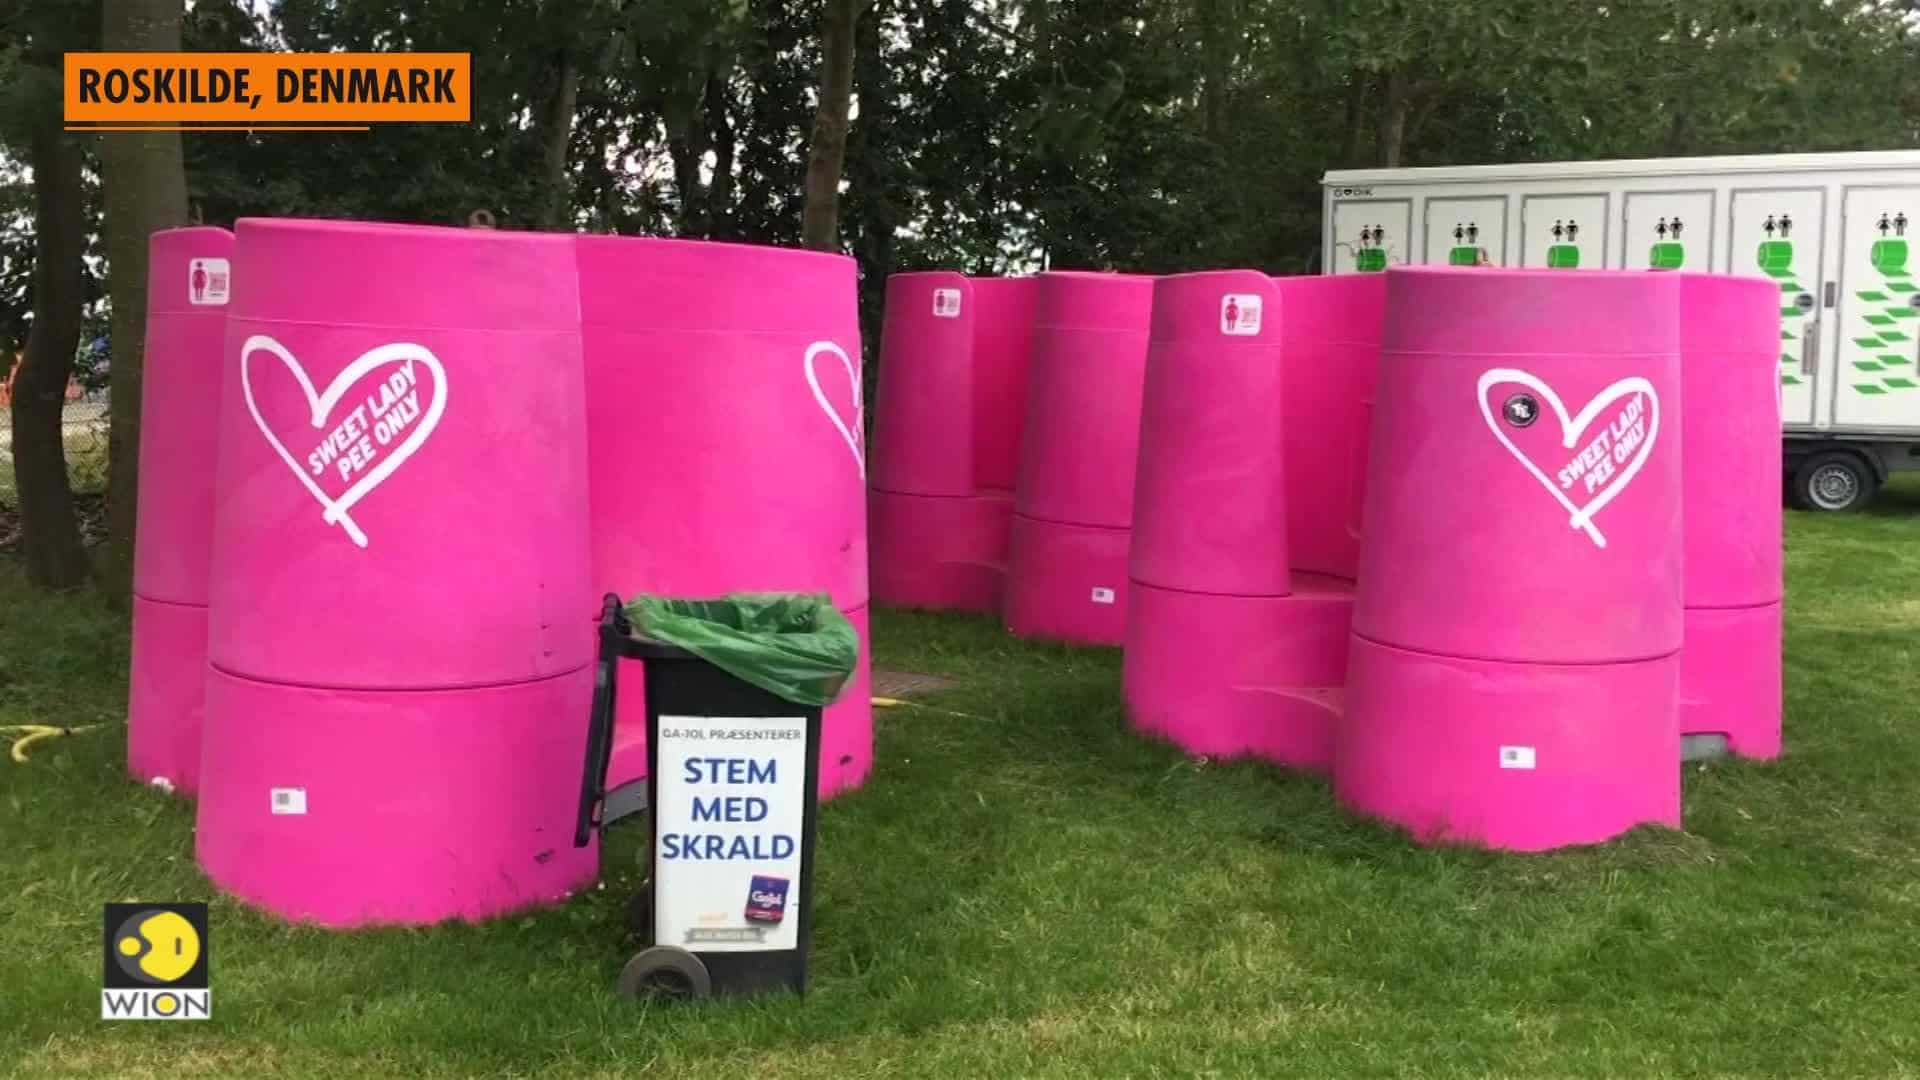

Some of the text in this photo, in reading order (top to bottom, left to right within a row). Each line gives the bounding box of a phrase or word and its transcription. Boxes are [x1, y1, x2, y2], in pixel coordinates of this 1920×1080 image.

[308, 359, 416, 476] SWEET LADY
[336, 389, 420, 483] PEE ONLY
[1557, 391, 1645, 489] SWEET LADY
[1583, 415, 1646, 495] PEE ONLY
[709, 728, 802, 741] PRÆSENTERER
[684, 757, 777, 785] STEM
[691, 796, 769, 823] MED
[661, 833, 795, 860] SKRALD
